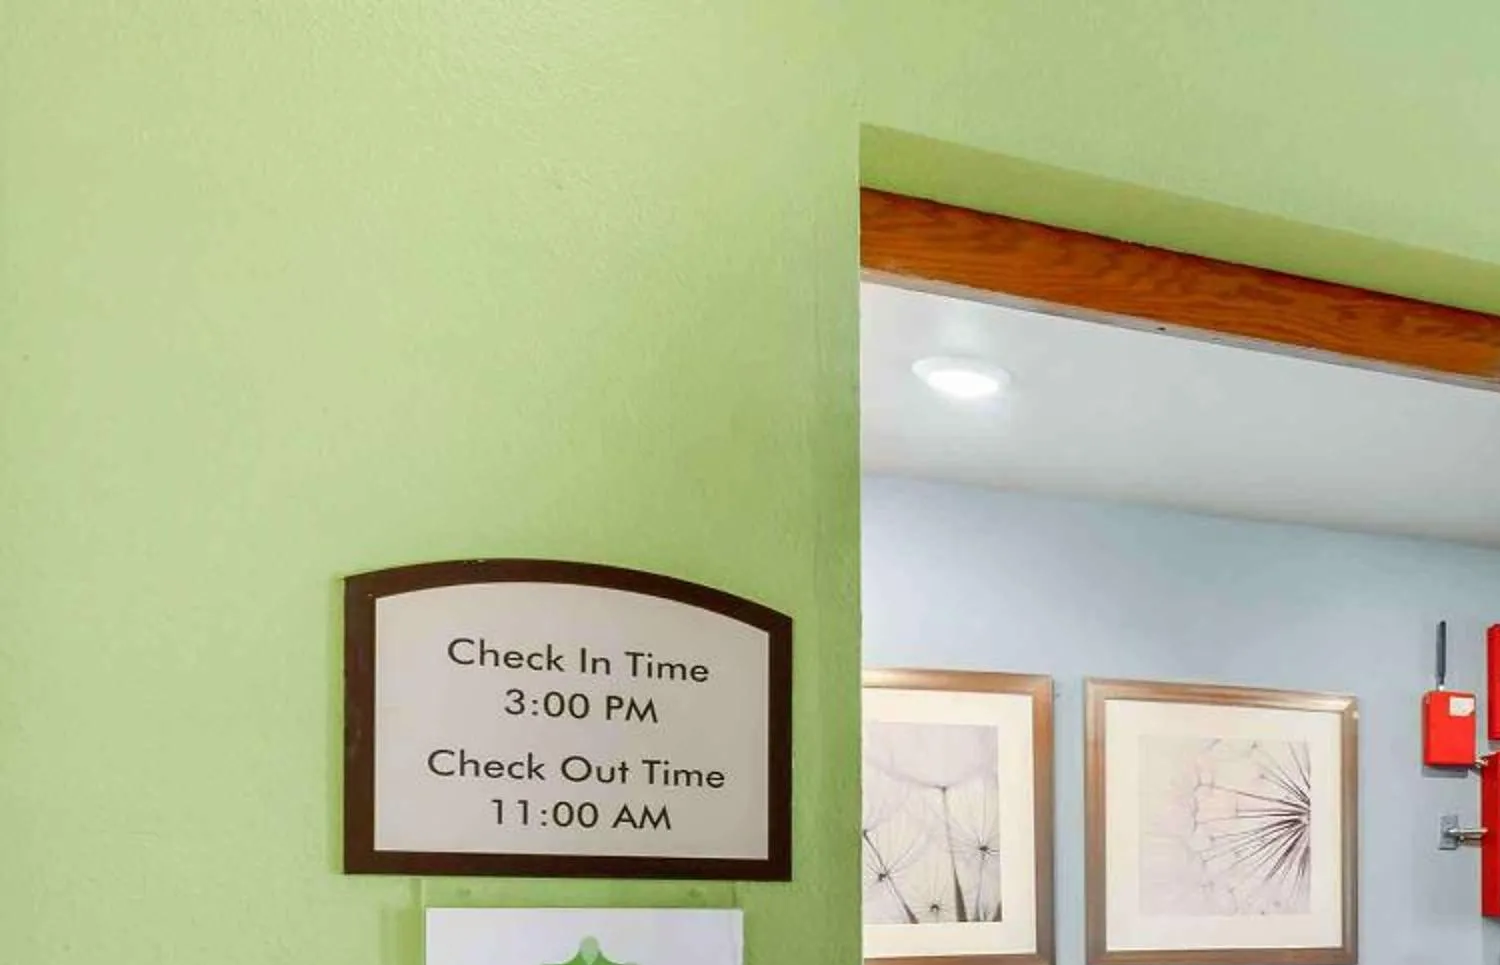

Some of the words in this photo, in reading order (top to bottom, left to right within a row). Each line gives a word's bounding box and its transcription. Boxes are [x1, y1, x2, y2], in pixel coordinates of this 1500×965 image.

[447, 637, 566, 674] Check
[580, 647, 612, 676] In
[624, 651, 710, 683] Time
[504, 688, 591, 720] 3:00
[605, 695, 659, 724] PM
[427, 749, 546, 782] Check
[560, 755, 631, 785] Out
[642, 759, 726, 789] Time
[491, 798, 599, 829] 11:00
[612, 803, 672, 831] AM
